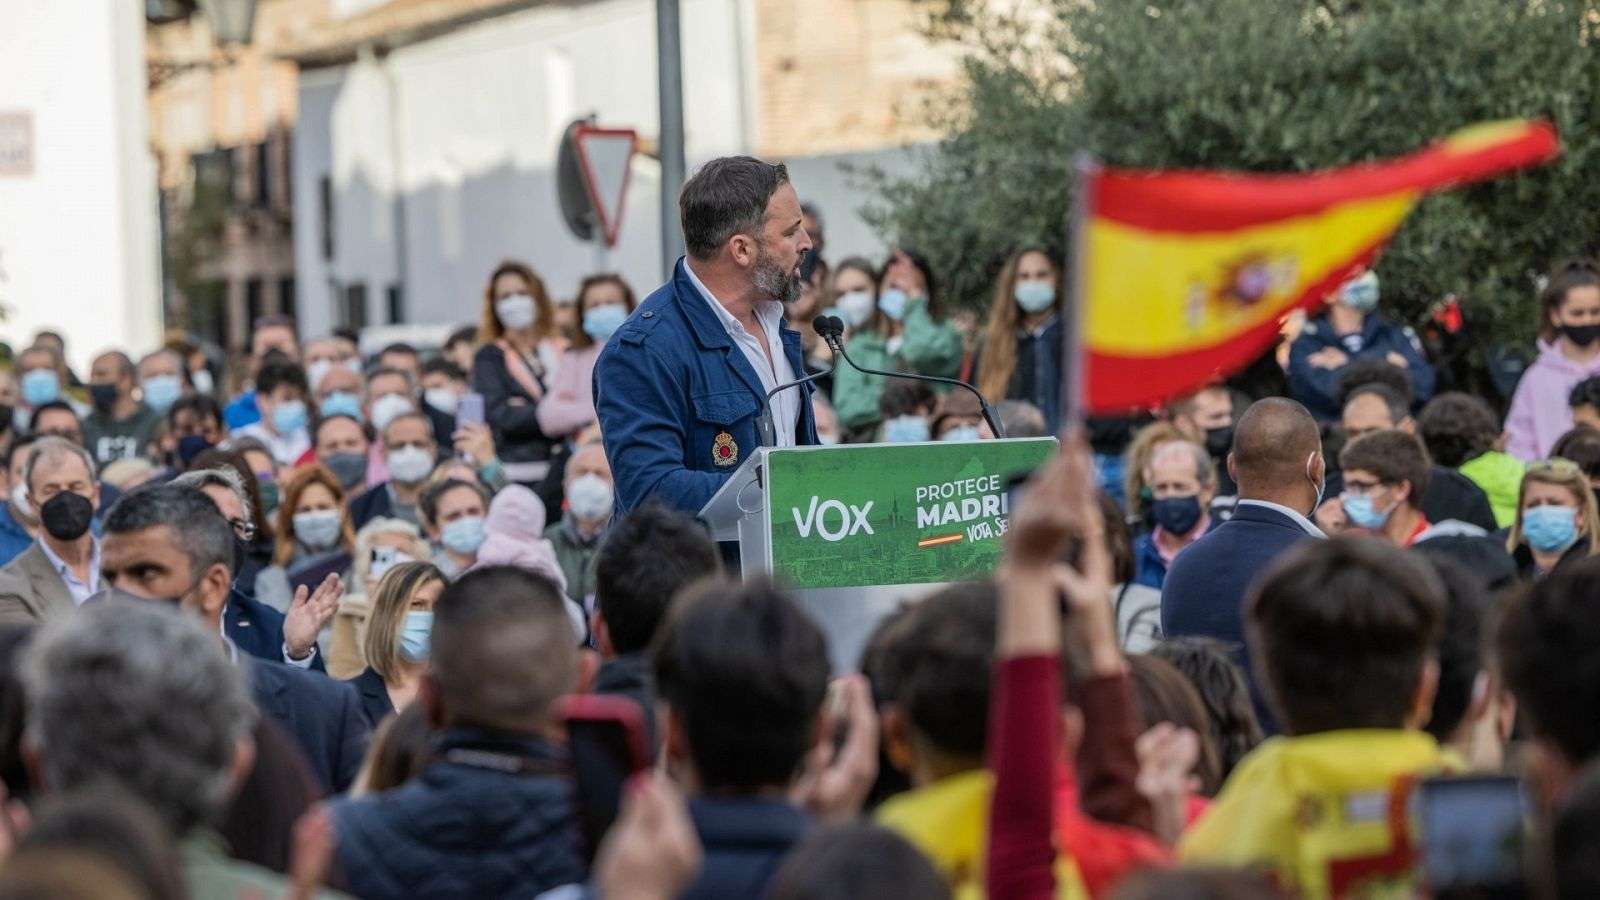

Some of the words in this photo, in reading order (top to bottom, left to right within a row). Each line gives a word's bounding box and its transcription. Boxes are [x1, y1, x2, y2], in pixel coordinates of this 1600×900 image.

[916, 474, 1001, 503] PROTEGE
[792, 495, 875, 541] VOX
[917, 492, 1009, 529] MADRI
[967, 521, 993, 543] VOTA
